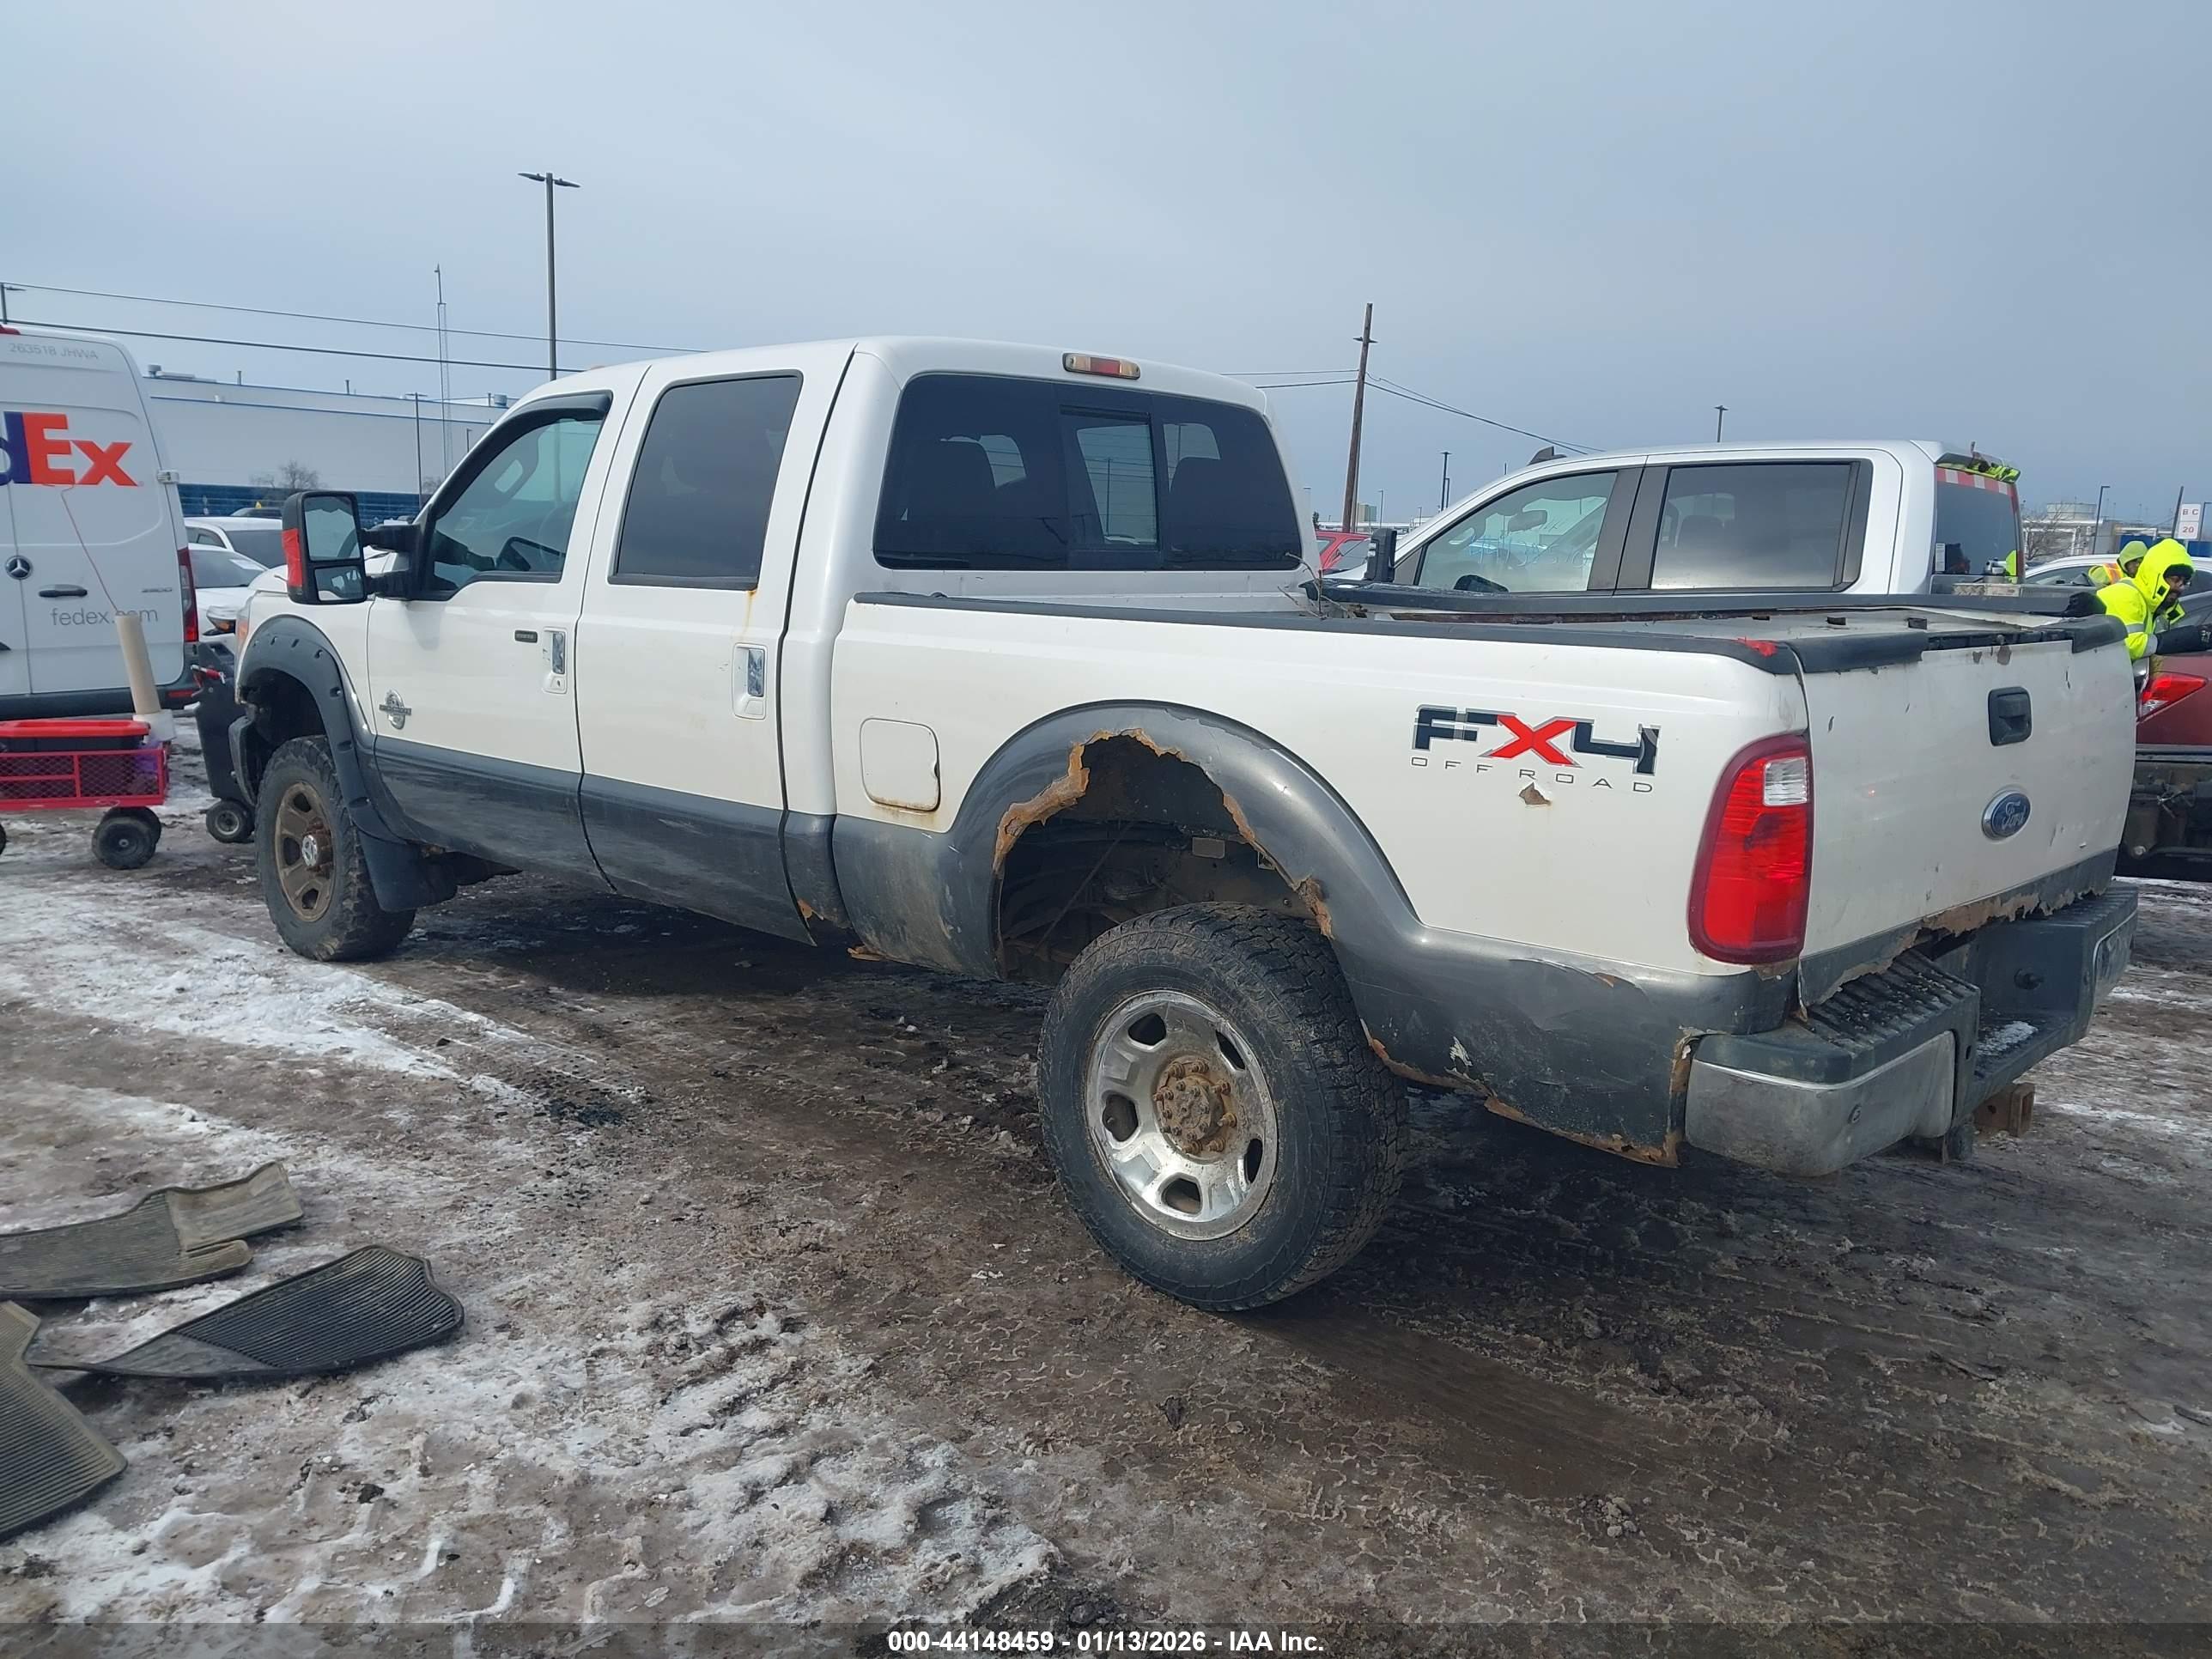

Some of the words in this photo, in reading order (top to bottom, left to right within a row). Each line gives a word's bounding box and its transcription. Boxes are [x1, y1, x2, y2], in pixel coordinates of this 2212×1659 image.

[1413, 704, 1662, 776] FX4
[1410, 757, 1493, 774] OFF
[1518, 769, 1653, 793] ROAD
